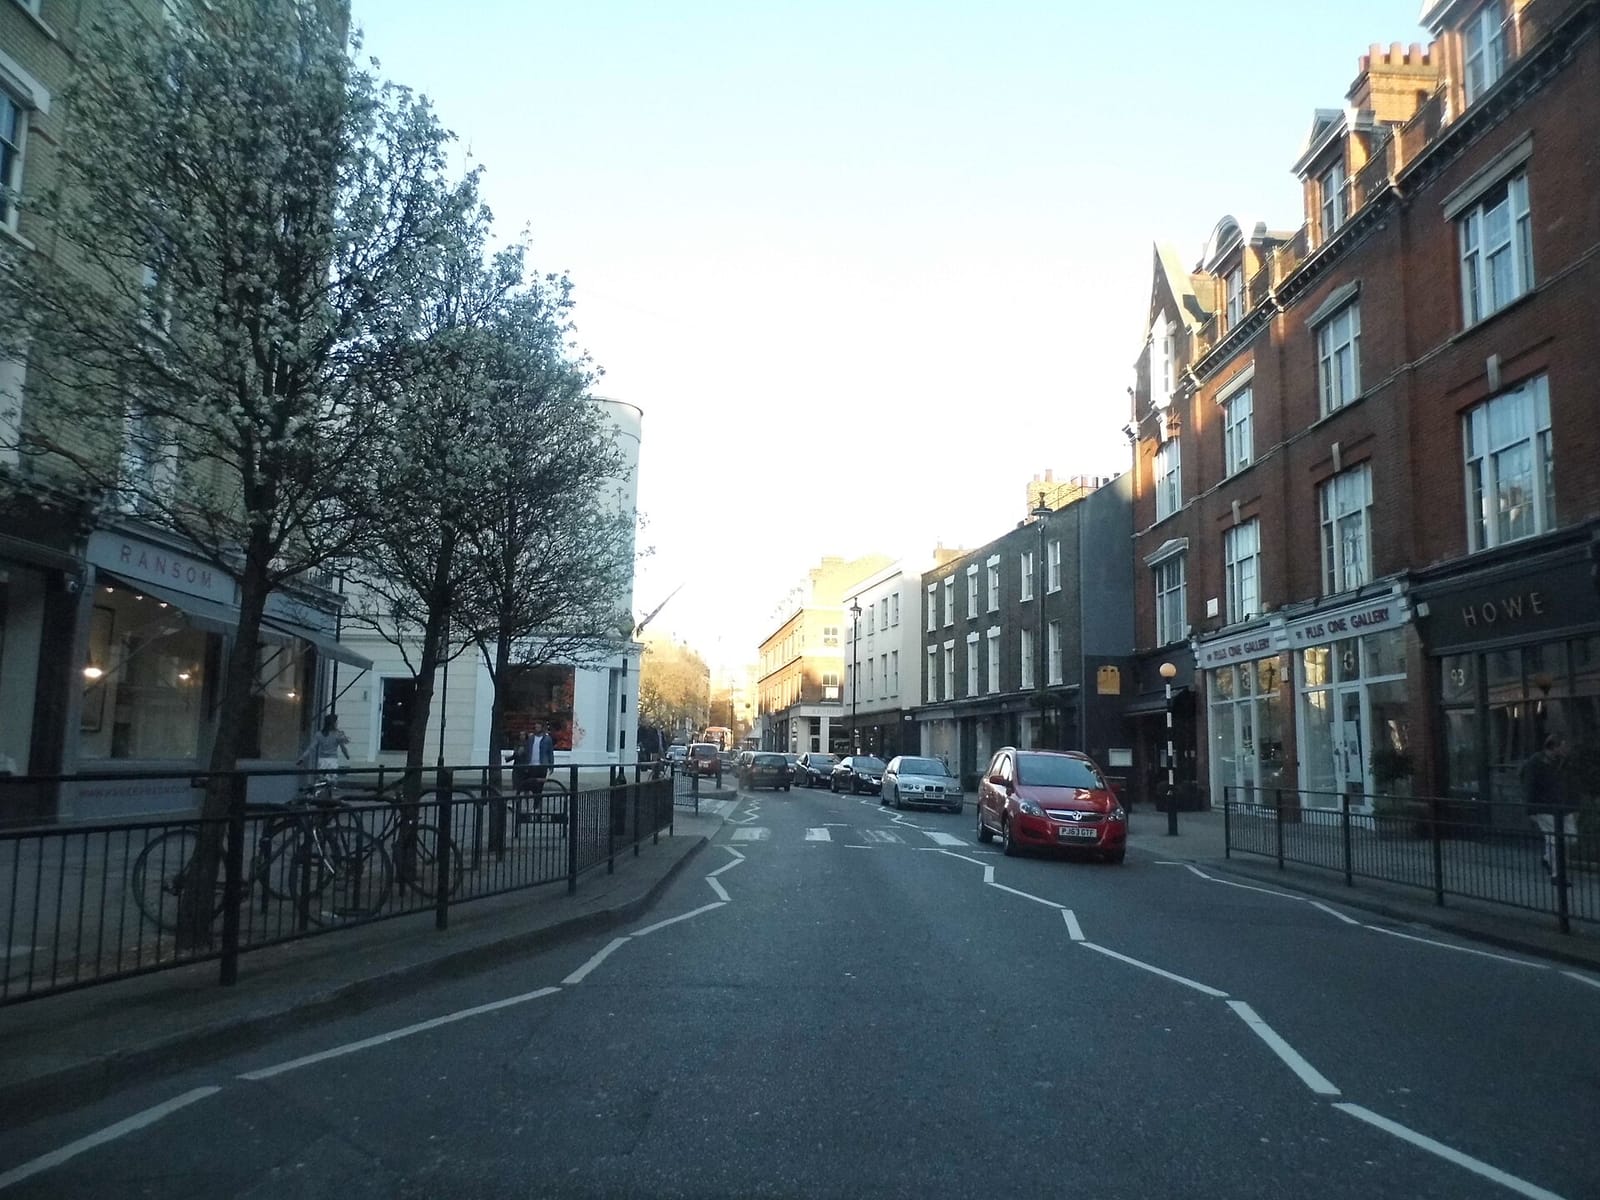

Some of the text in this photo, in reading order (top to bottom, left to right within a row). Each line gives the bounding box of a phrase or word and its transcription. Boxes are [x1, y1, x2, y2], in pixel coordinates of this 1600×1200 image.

[120, 544, 213, 589] RANSOM
[1305, 624, 1325, 640] PLUS
[1327, 618, 1348, 634] ONE
[1350, 607, 1390, 629] GALLERY
[1462, 592, 1544, 627] HOWE
[1244, 637, 1271, 654] GALLERY
[1450, 668, 1465, 686] 93
